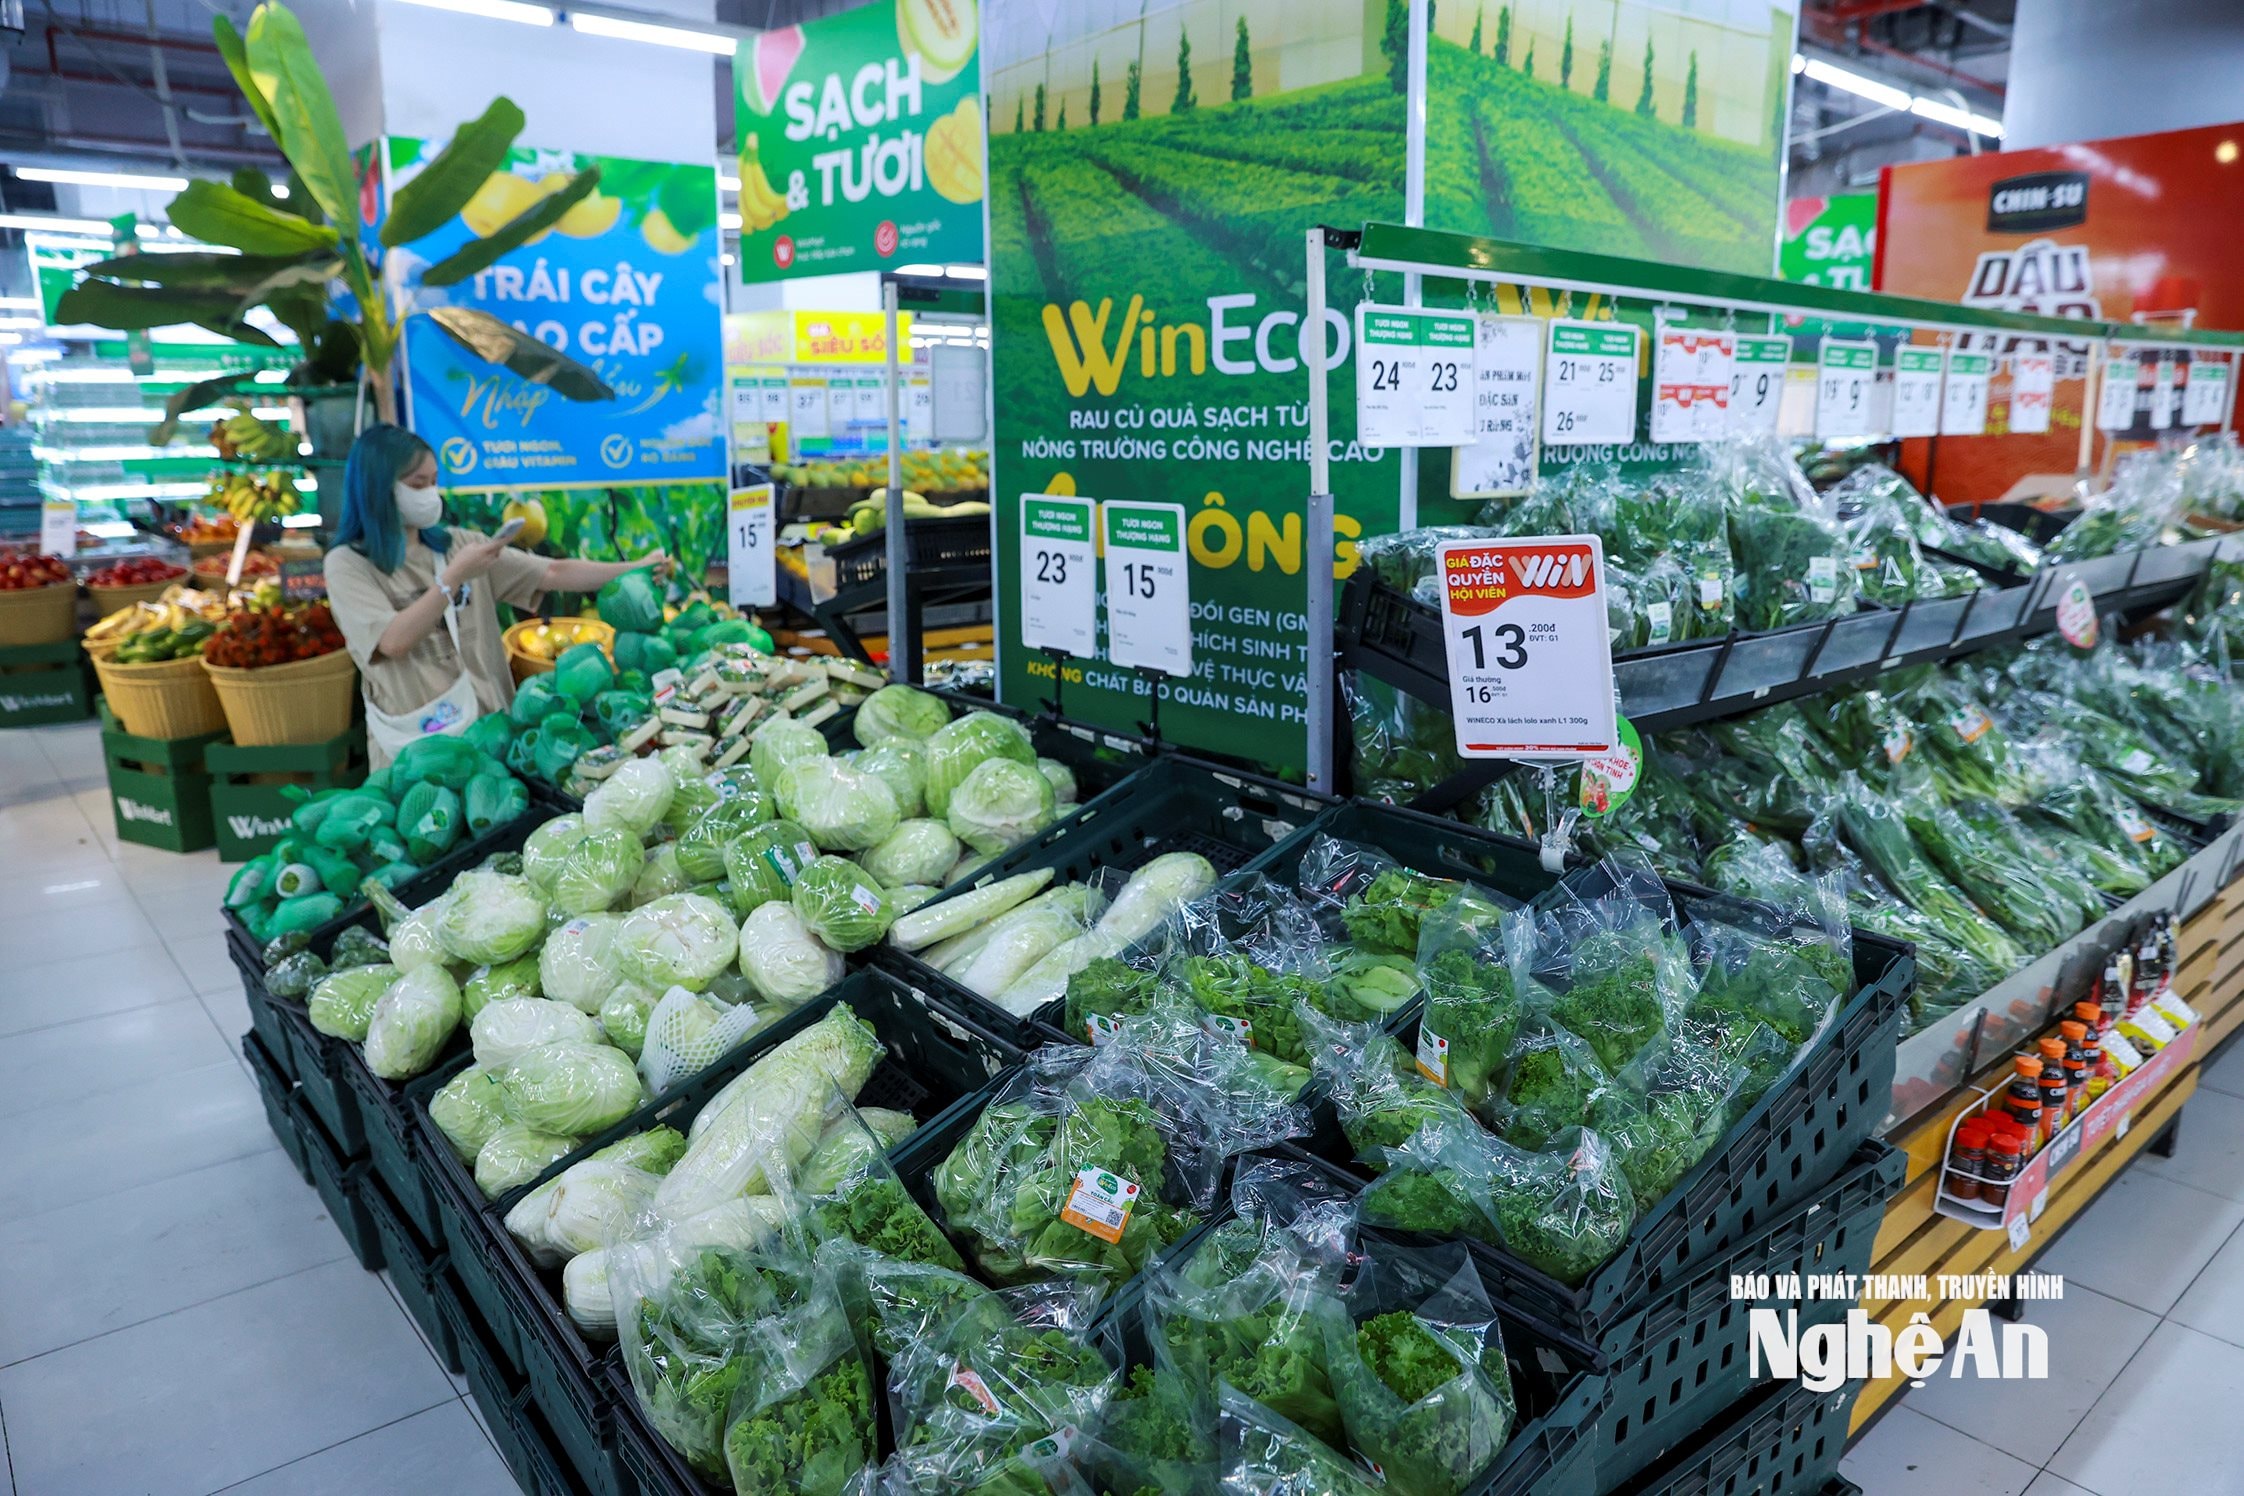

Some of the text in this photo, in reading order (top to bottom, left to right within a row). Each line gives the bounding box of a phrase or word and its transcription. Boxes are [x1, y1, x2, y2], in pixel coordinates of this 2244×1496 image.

[785, 52, 922, 142] SẠCH
[786, 129, 923, 211] & TƯƠI
[1992, 182, 2084, 215] CHIN-SU
[473, 257, 664, 306] TRÁI CÂY
[578, 308, 665, 356] CẤP
[860, 326, 885, 352] SỐ
[1041, 293, 1351, 398] WinEco
[1372, 360, 1400, 391] 24
[1431, 362, 1457, 391] 23
[1560, 361, 1575, 381] 21
[1599, 362, 1615, 382] 25
[1757, 373, 1769, 407] 9
[1070, 409, 1110, 429] RAU
[1114, 403, 1145, 429] CỦ
[1150, 402, 1198, 429] QUẢ
[1203, 405, 1268, 433] SẠCH
[1557, 411, 1574, 431] 26
[1022, 435, 1077, 460] NÔNG
[1081, 437, 1167, 461] TRƯỜNG
[1172, 436, 1240, 461] CÔNG
[1327, 438, 1385, 463] CAO
[739, 524, 757, 548] 15
[1036, 551, 1067, 585] 23
[1446, 552, 1504, 570] GIÁ ĐẶC
[1124, 563, 1156, 599] 15
[1448, 567, 1505, 587] QUYỀN
[1450, 585, 1507, 602] HỘI VIÊN
[1228, 606, 1271, 628] GEN
[1191, 631, 1237, 657] HÍCH
[1242, 636, 1291, 661] SINH
[1462, 623, 1556, 670] 13 .200đ
[1219, 664, 1276, 691] THỰC
[1281, 671, 1308, 699] VẬ
[1462, 675, 1474, 683] Giá
[1085, 671, 1128, 693] CHẤT
[1174, 687, 1230, 711] QUẢN
[1234, 695, 1275, 719] SẢN
[1466, 686, 1491, 703] 16
[1496, 716, 1506, 724] Xà
[1507, 716, 1523, 725] lách
[1524, 716, 1537, 725] lolo
[1539, 716, 1557, 725] xanh
[1558, 716, 1567, 724] L1
[1569, 716, 1588, 726] 300g
[227, 815, 292, 840] WinM
